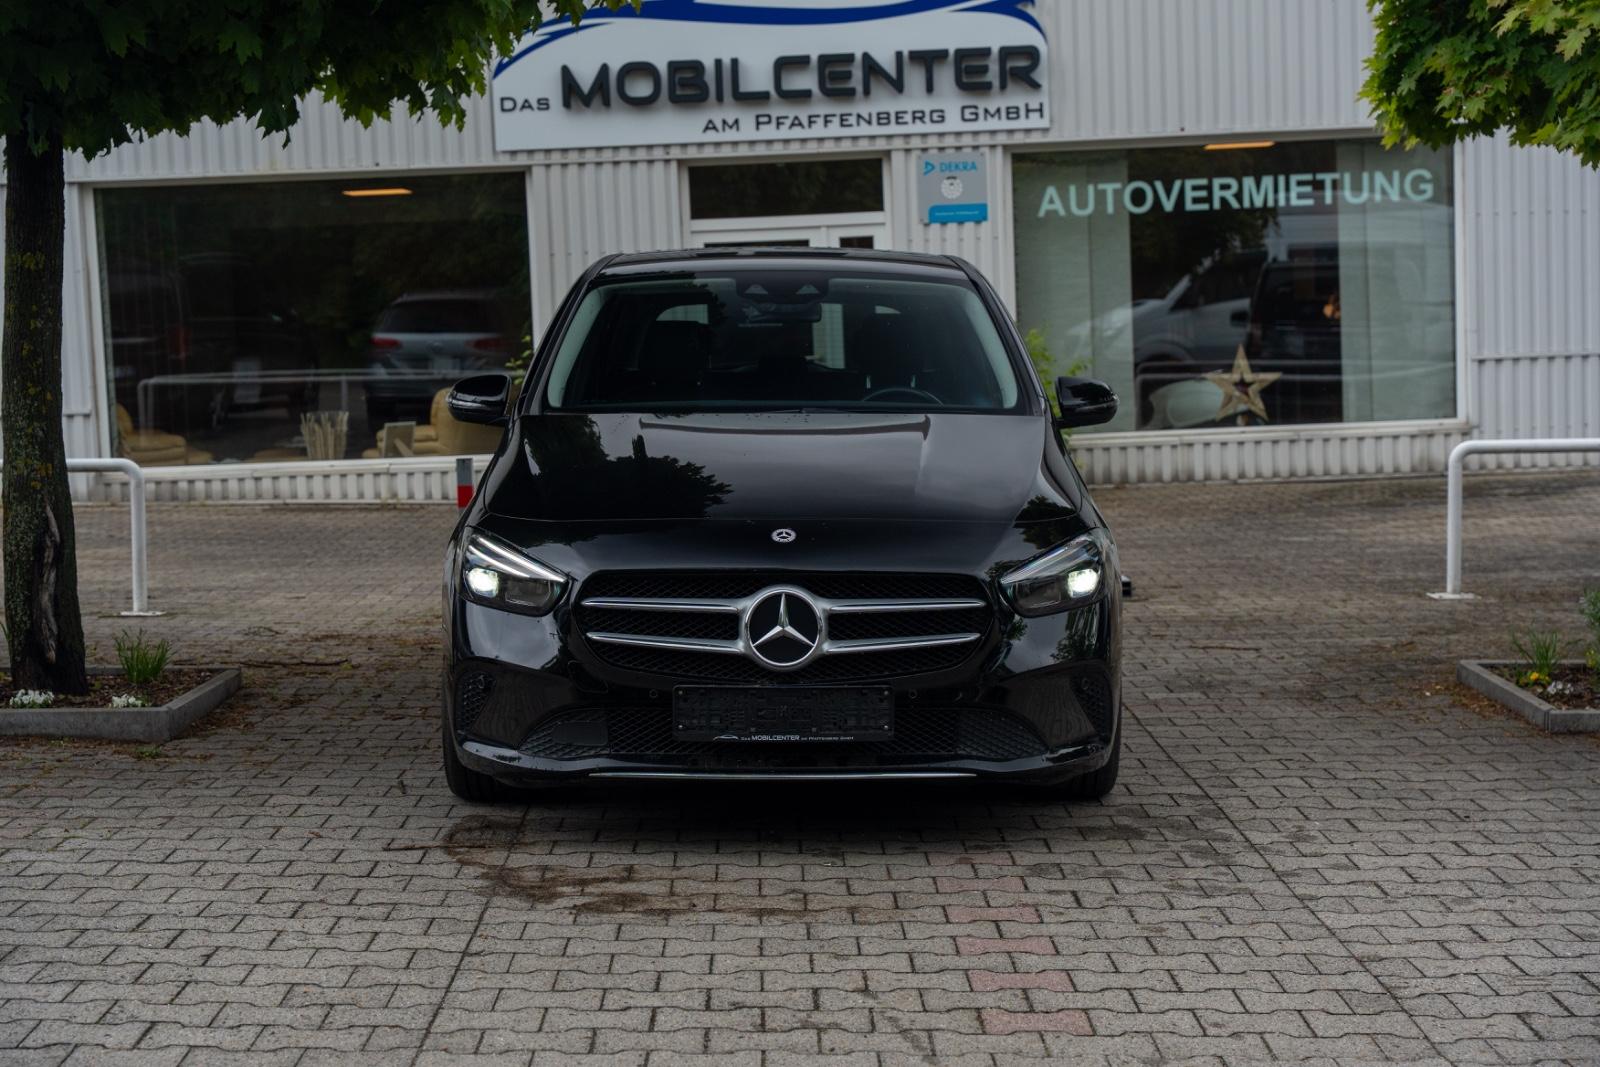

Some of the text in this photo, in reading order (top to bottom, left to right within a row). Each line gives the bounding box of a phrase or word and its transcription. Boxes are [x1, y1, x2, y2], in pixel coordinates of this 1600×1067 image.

[500, 45, 1042, 112] DAS MOBILCENTER
[702, 118, 740, 133] AM
[755, 109, 946, 131] PFAFFENBERG
[939, 160, 977, 172] DEKRA
[1037, 168, 1434, 218] AUTOVERMIETUNG
